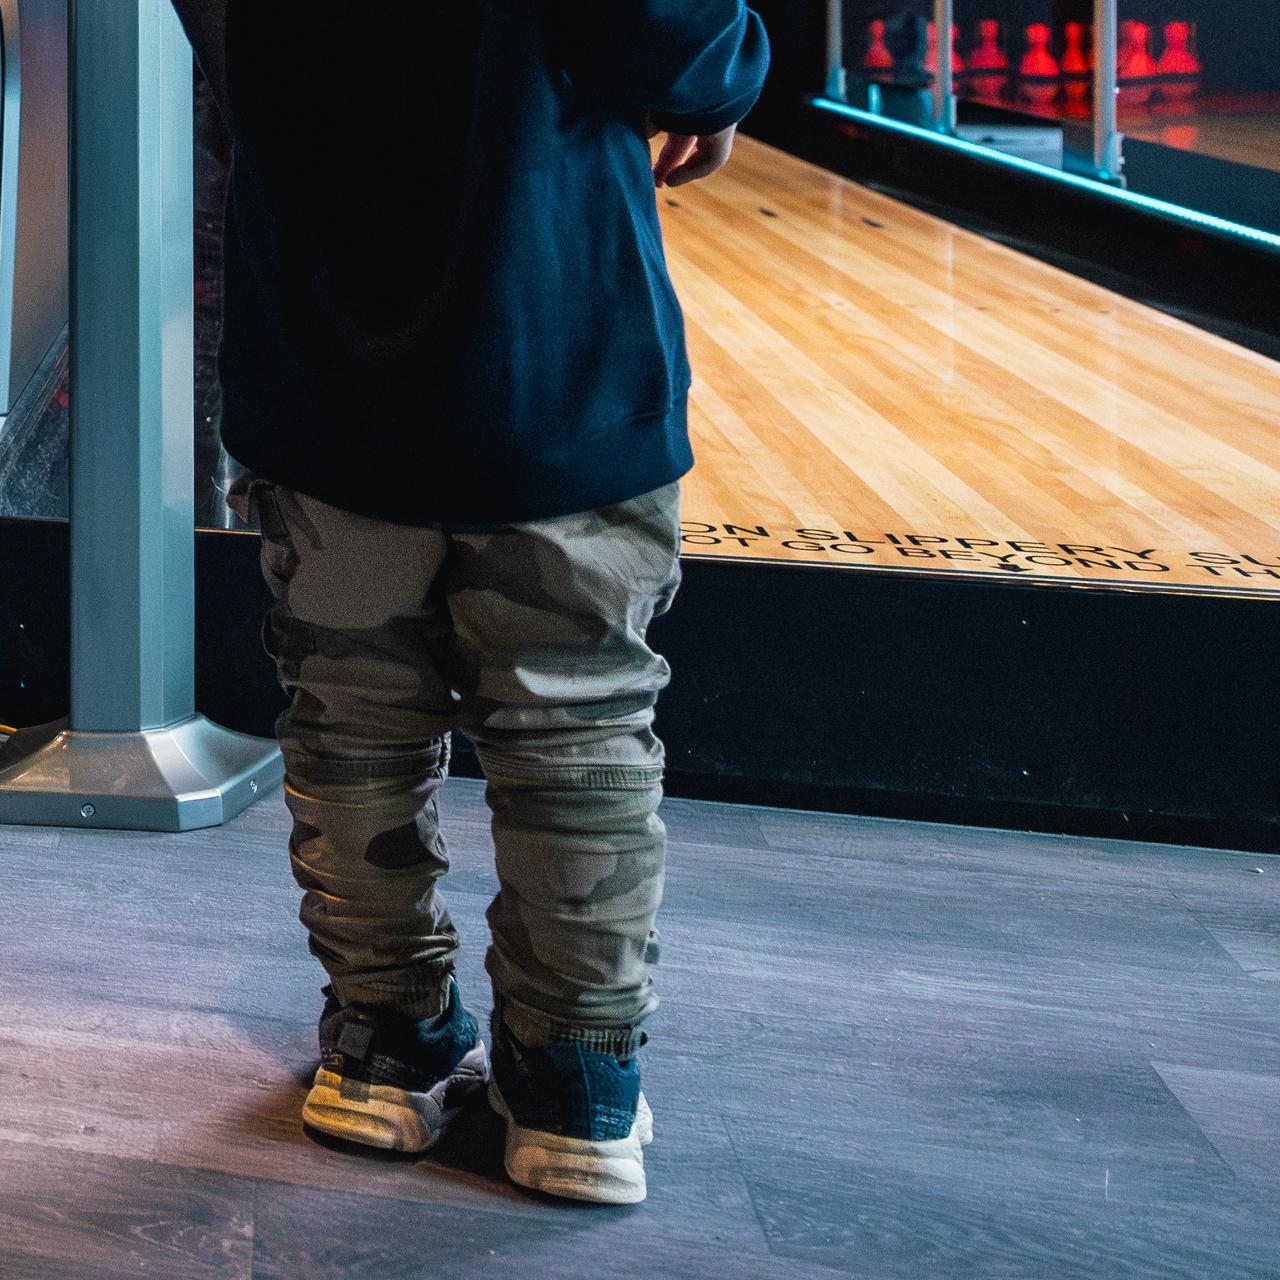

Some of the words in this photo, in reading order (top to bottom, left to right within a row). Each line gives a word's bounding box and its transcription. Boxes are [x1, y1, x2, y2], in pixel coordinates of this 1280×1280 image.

[781, 539, 874, 555] GO
[896, 545, 1170, 573] BEYOND
[795, 527, 1157, 561] SLIPPERY
